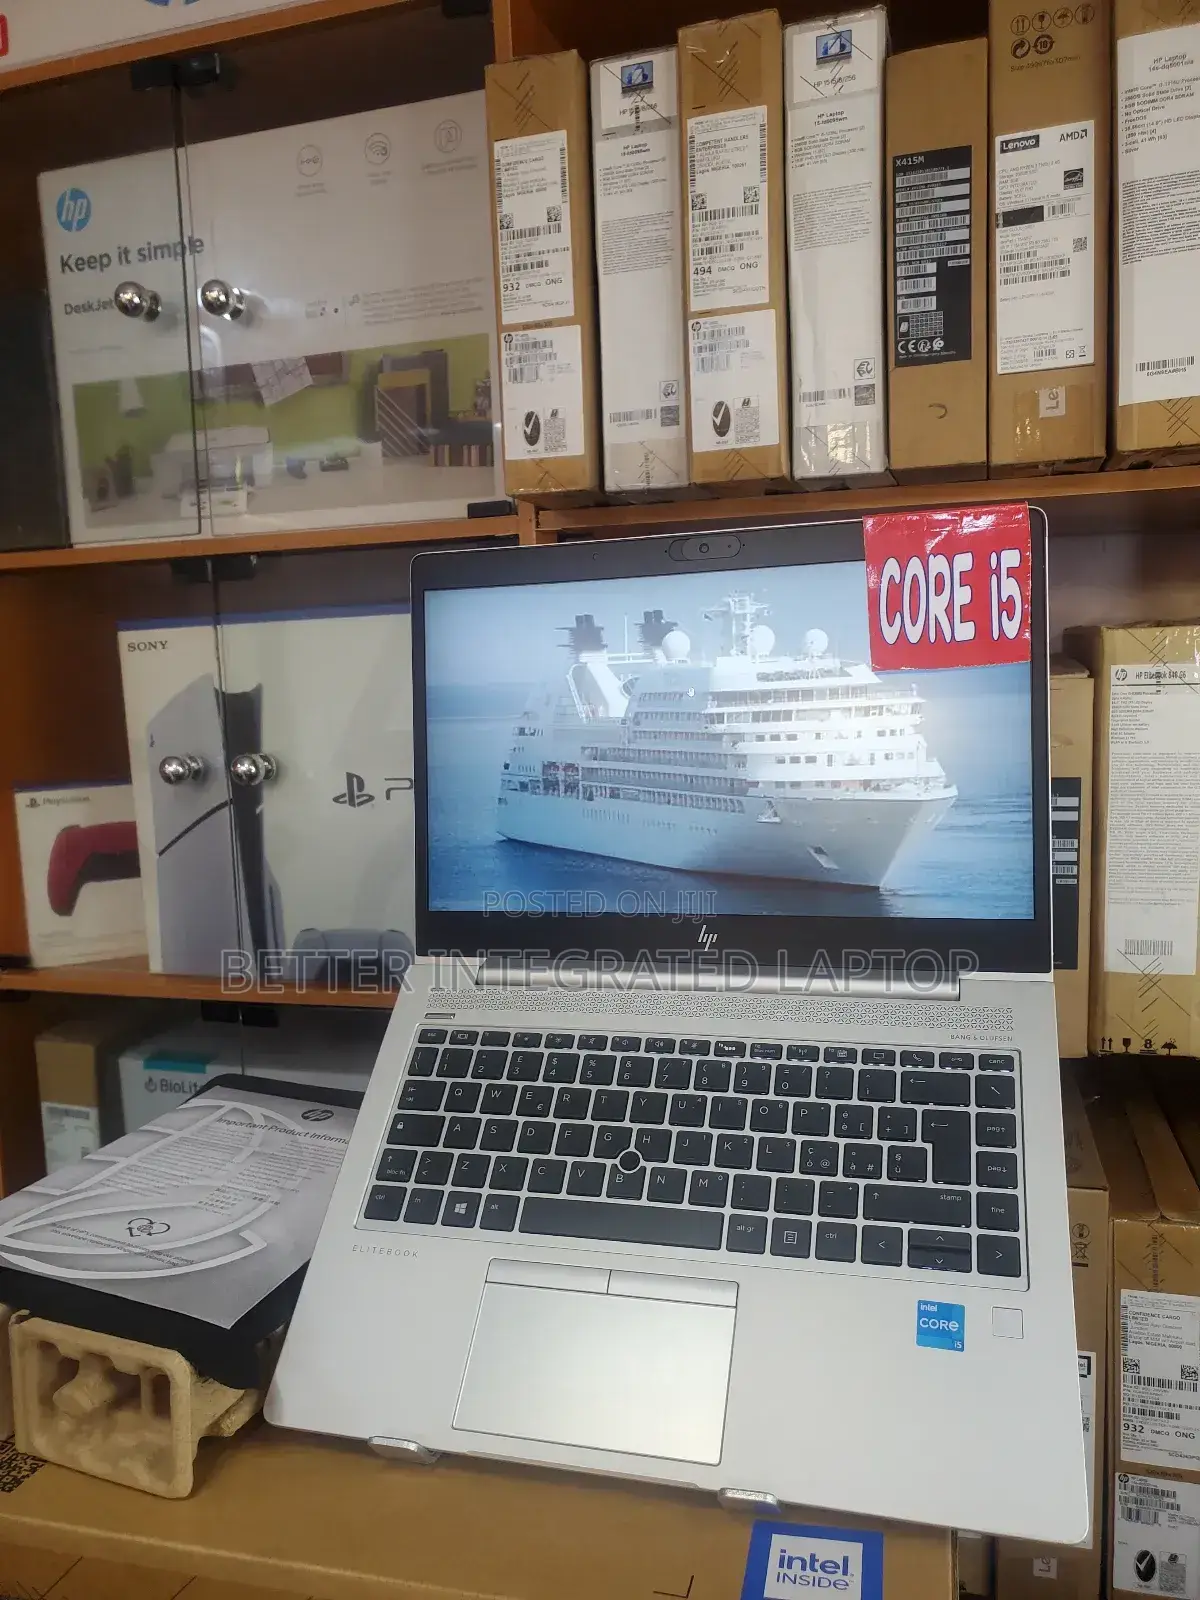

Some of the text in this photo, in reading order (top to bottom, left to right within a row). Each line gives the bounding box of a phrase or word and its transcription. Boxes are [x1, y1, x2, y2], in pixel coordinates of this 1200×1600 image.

[1164, 54, 1187, 63] Laptop
[826, 110, 845, 118] Laptop
[1124, 115, 1147, 125] FreeDOS
[696, 138, 723, 148] COMPETENT
[1002, 130, 1080, 150] Lenovo AMD
[895, 155, 925, 168] X415M
[58, 188, 91, 232] hp
[60, 236, 204, 274] Keep it simple
[693, 266, 713, 276] 494
[740, 261, 759, 270] ONG
[503, 281, 520, 293] 932
[545, 277, 563, 286] ONG
[64, 298, 115, 315] DeskJet
[879, 548, 1023, 645] CORE i5
[127, 640, 168, 652] SONY
[160, 1079, 203, 1094] BioLit
[454, 1088, 463, 1097] Q
[491, 1090, 502, 1098] W
[526, 1092, 533, 1100] E
[562, 1094, 571, 1102] R
[601, 1095, 608, 1104] T
[639, 1098, 647, 1106] Y
[678, 1100, 686, 1109] U
[759, 1106, 768, 1115] O
[800, 1108, 808, 1117] P
[216, 1117, 268, 1131] Important
[268, 1125, 310, 1137] Product
[453, 1123, 461, 1132] A
[490, 1125, 497, 1134] S
[527, 1128, 535, 1136] D
[564, 1130, 572, 1138] F
[604, 1133, 612, 1141] G
[642, 1135, 650, 1143] H
[724, 1142, 732, 1150] K
[766, 1145, 772, 1154] L
[461, 1161, 470, 1169] Z
[499, 1163, 508, 1172] X
[537, 1166, 546, 1175] C
[577, 1169, 586, 1178] V
[615, 1174, 623, 1182] B
[657, 1175, 665, 1184] N
[698, 1178, 708, 1187] M
[939, 1193, 962, 1202] stamp
[991, 1206, 1005, 1214] fine
[824, 1231, 837, 1239] ctrl
[353, 1244, 419, 1258] ELITEBOOK
[920, 1303, 938, 1312] intel
[1129, 1310, 1160, 1319] CONFIDENCE
[954, 1340, 962, 1349] i5
[1123, 1422, 1145, 1434] 932
[1174, 1430, 1196, 1440] ONG
[778, 1548, 850, 1577] intel
